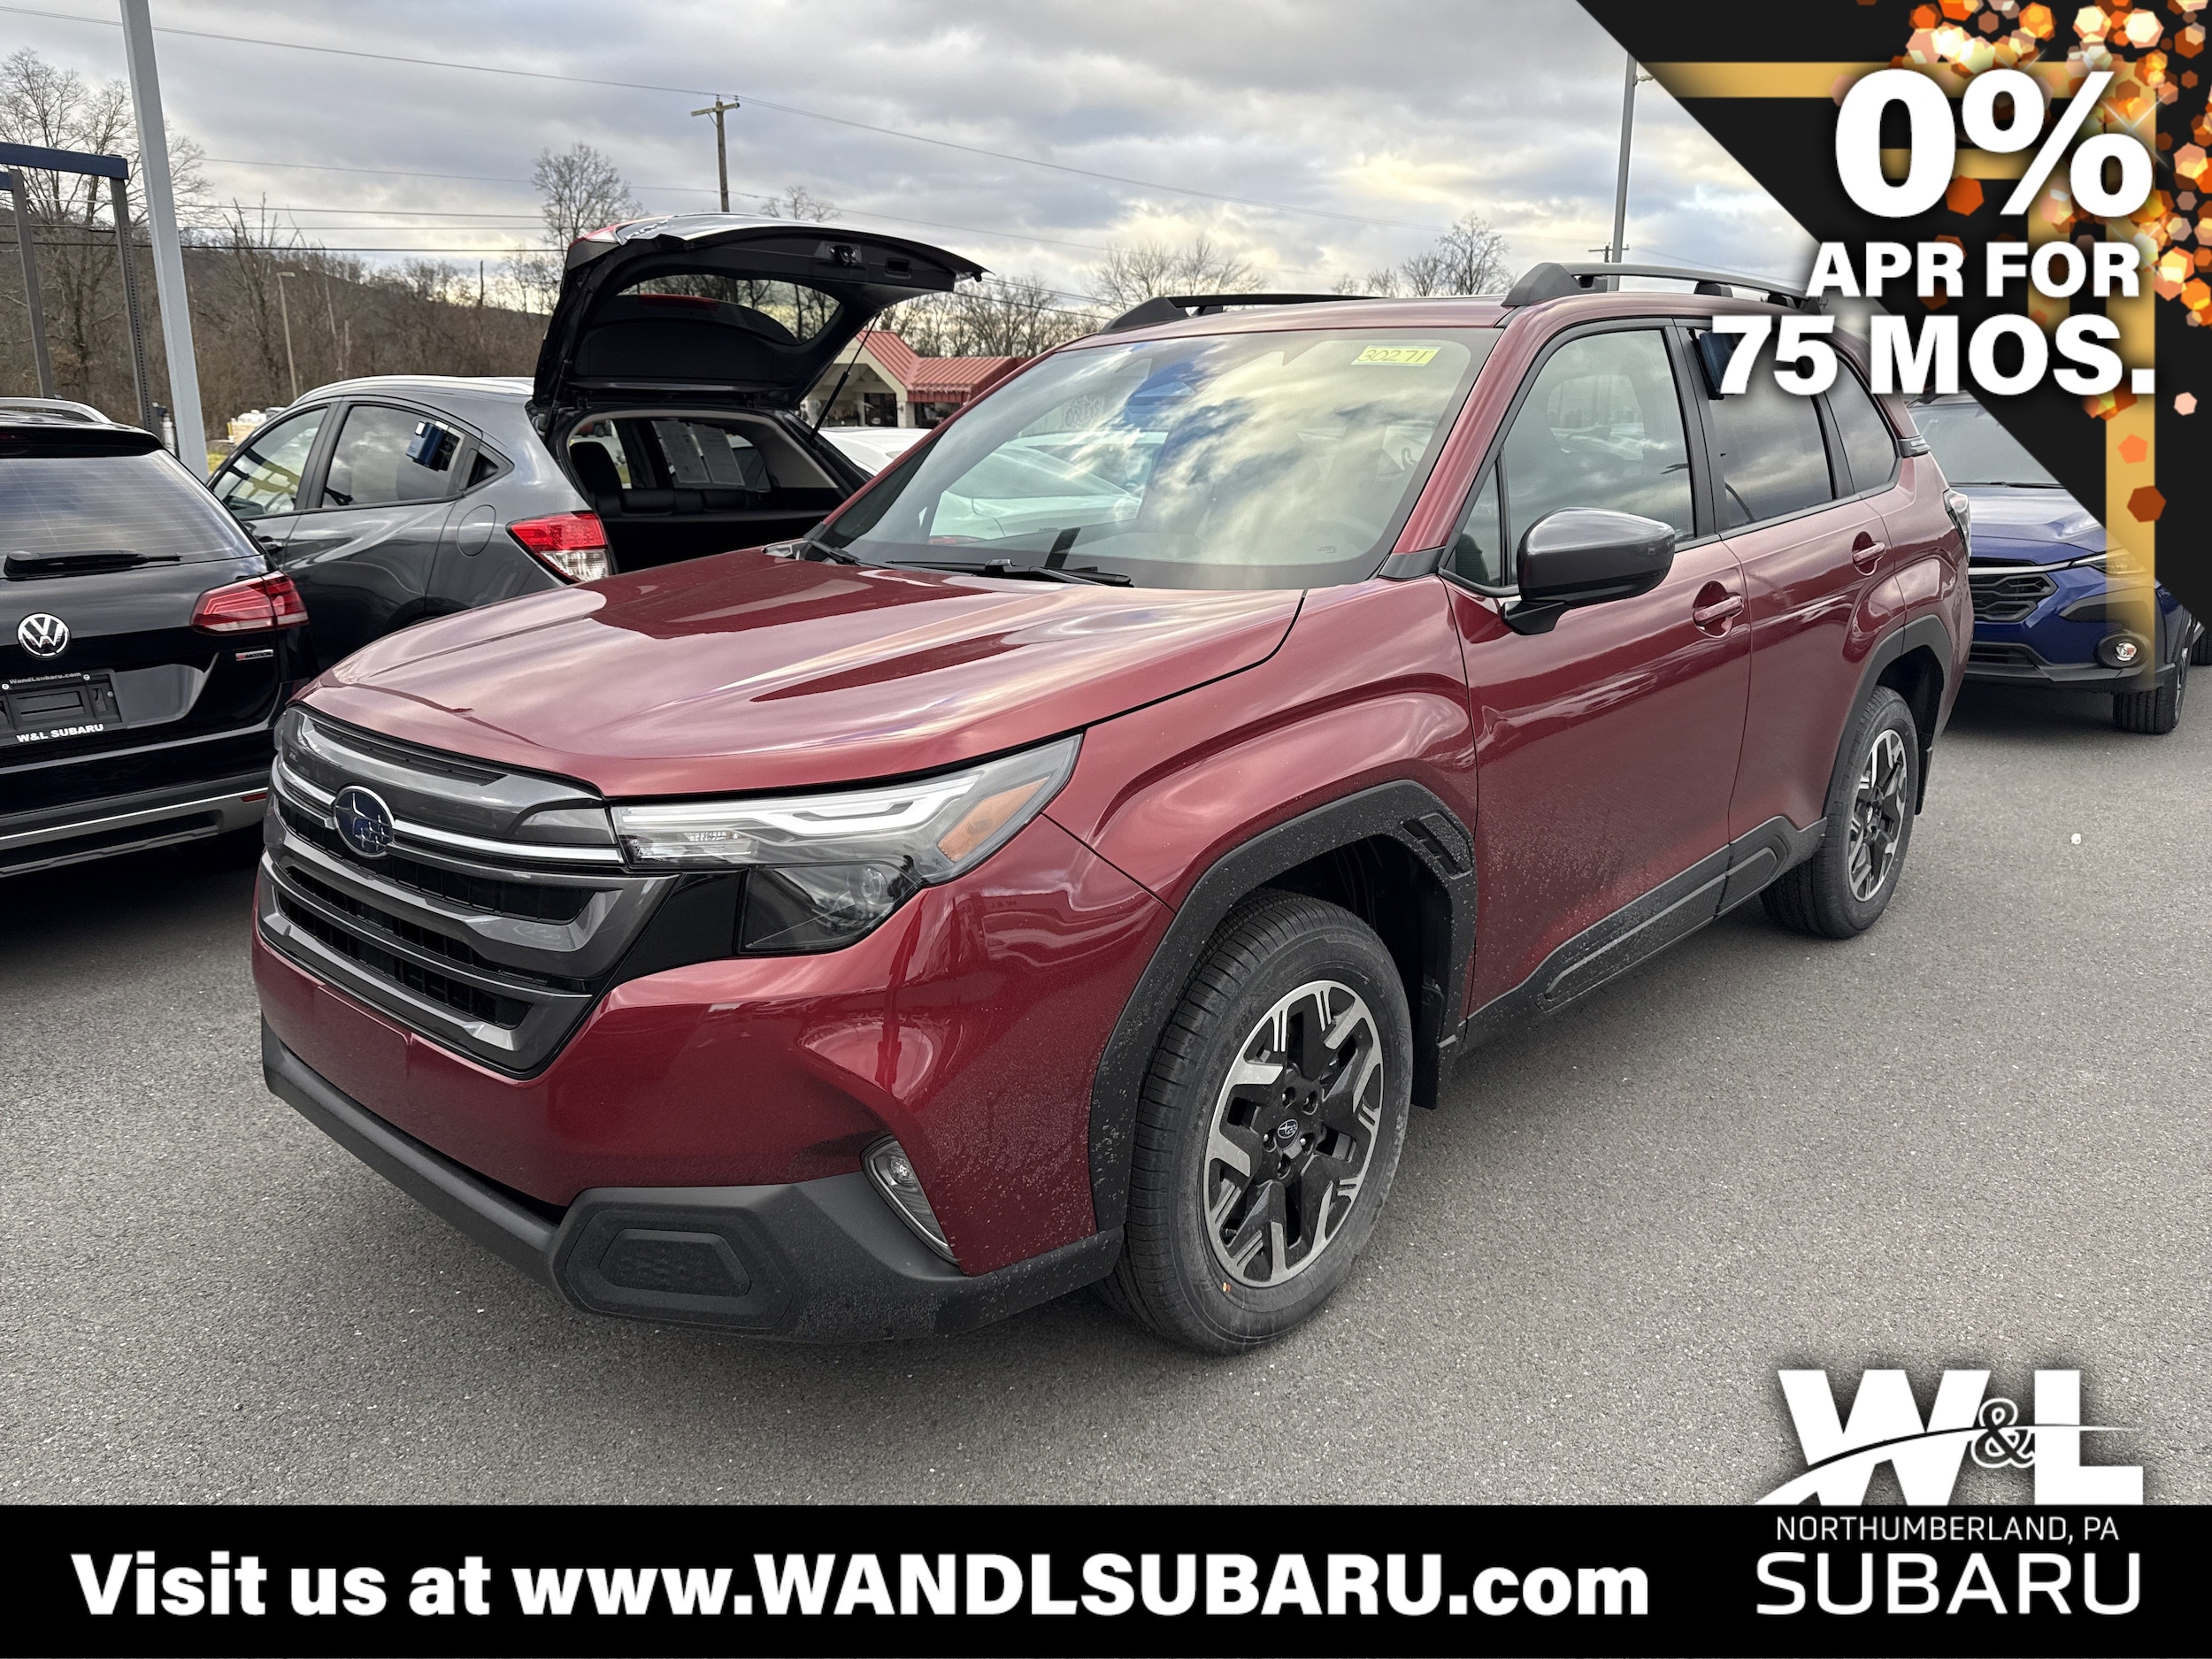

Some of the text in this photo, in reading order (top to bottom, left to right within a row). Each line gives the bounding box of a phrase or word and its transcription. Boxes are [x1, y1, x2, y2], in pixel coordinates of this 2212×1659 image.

[18, 613, 69, 657] VW
[16, 723, 104, 743] W&L SUBARU
